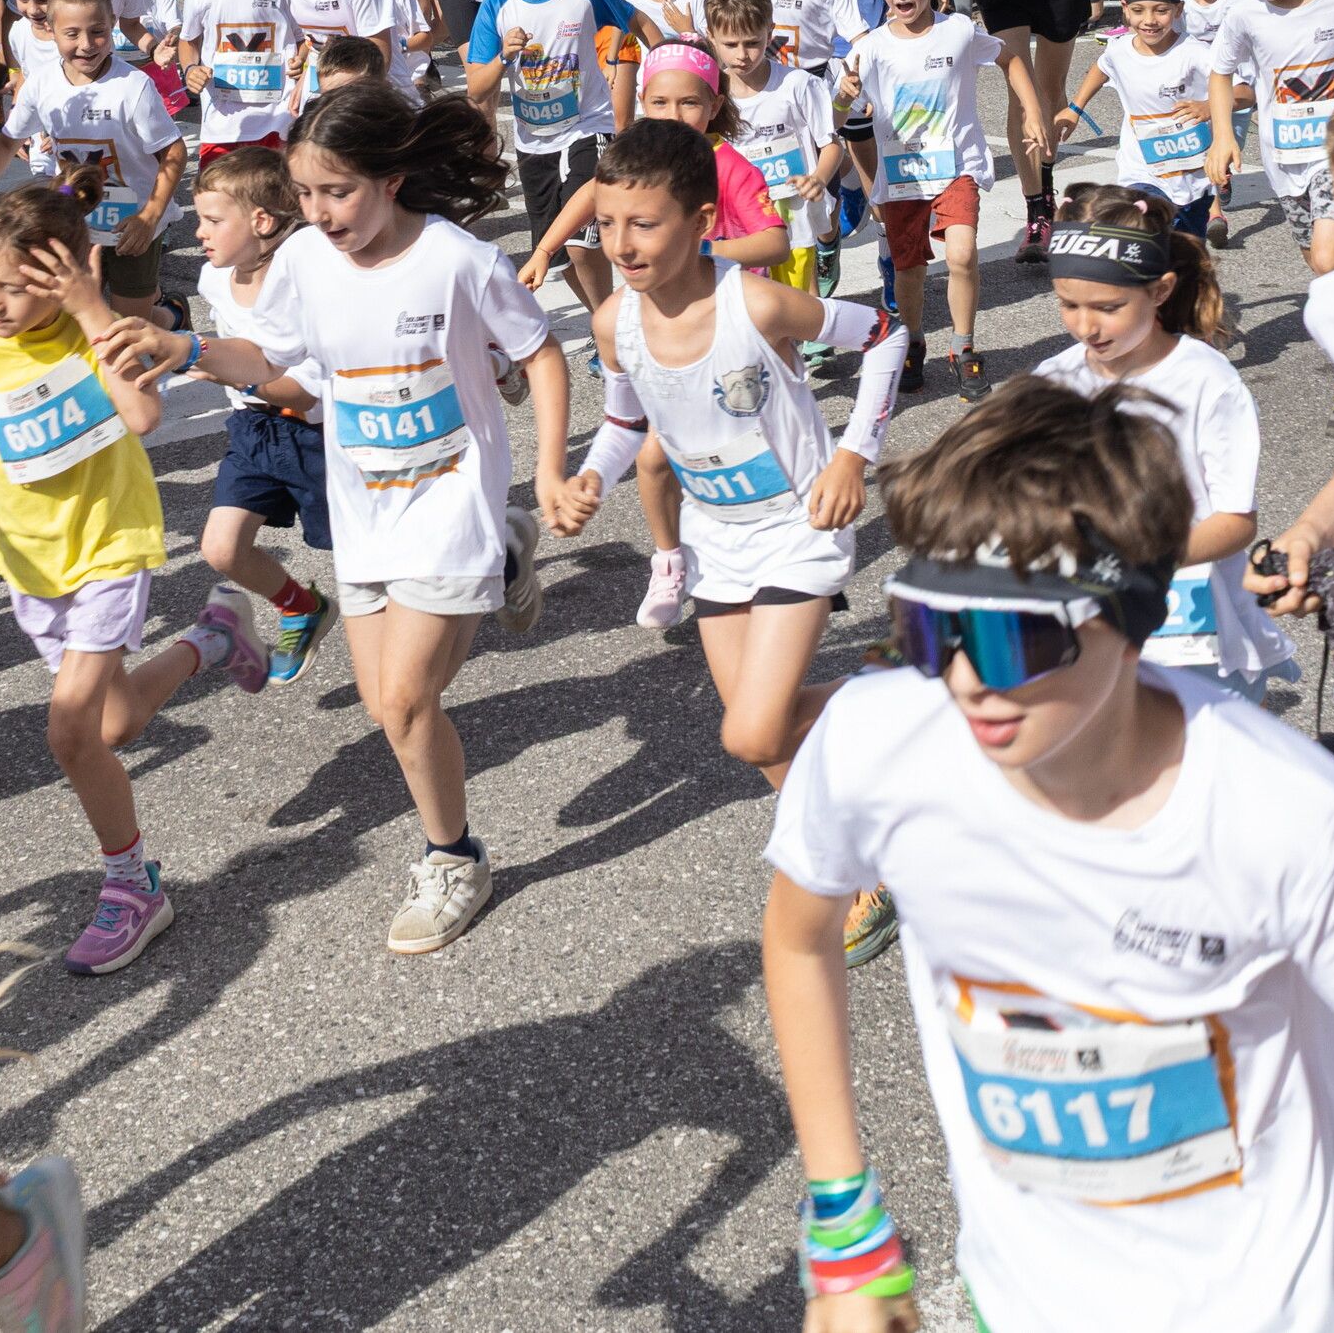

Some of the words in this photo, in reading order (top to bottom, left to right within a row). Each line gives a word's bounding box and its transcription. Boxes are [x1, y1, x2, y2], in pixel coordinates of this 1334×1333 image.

[227, 68, 269, 86] 6192
[520, 102, 564, 118] 6049
[1278, 120, 1327, 144] 6044
[1153, 132, 1201, 157] 6045
[762, 159, 790, 181] 26
[92, 206, 120, 226] 15
[1048, 234, 1120, 260] FUGA
[3, 396, 87, 452] 6074
[358, 404, 435, 441] 6141
[977, 1082, 1155, 1148] 6117
